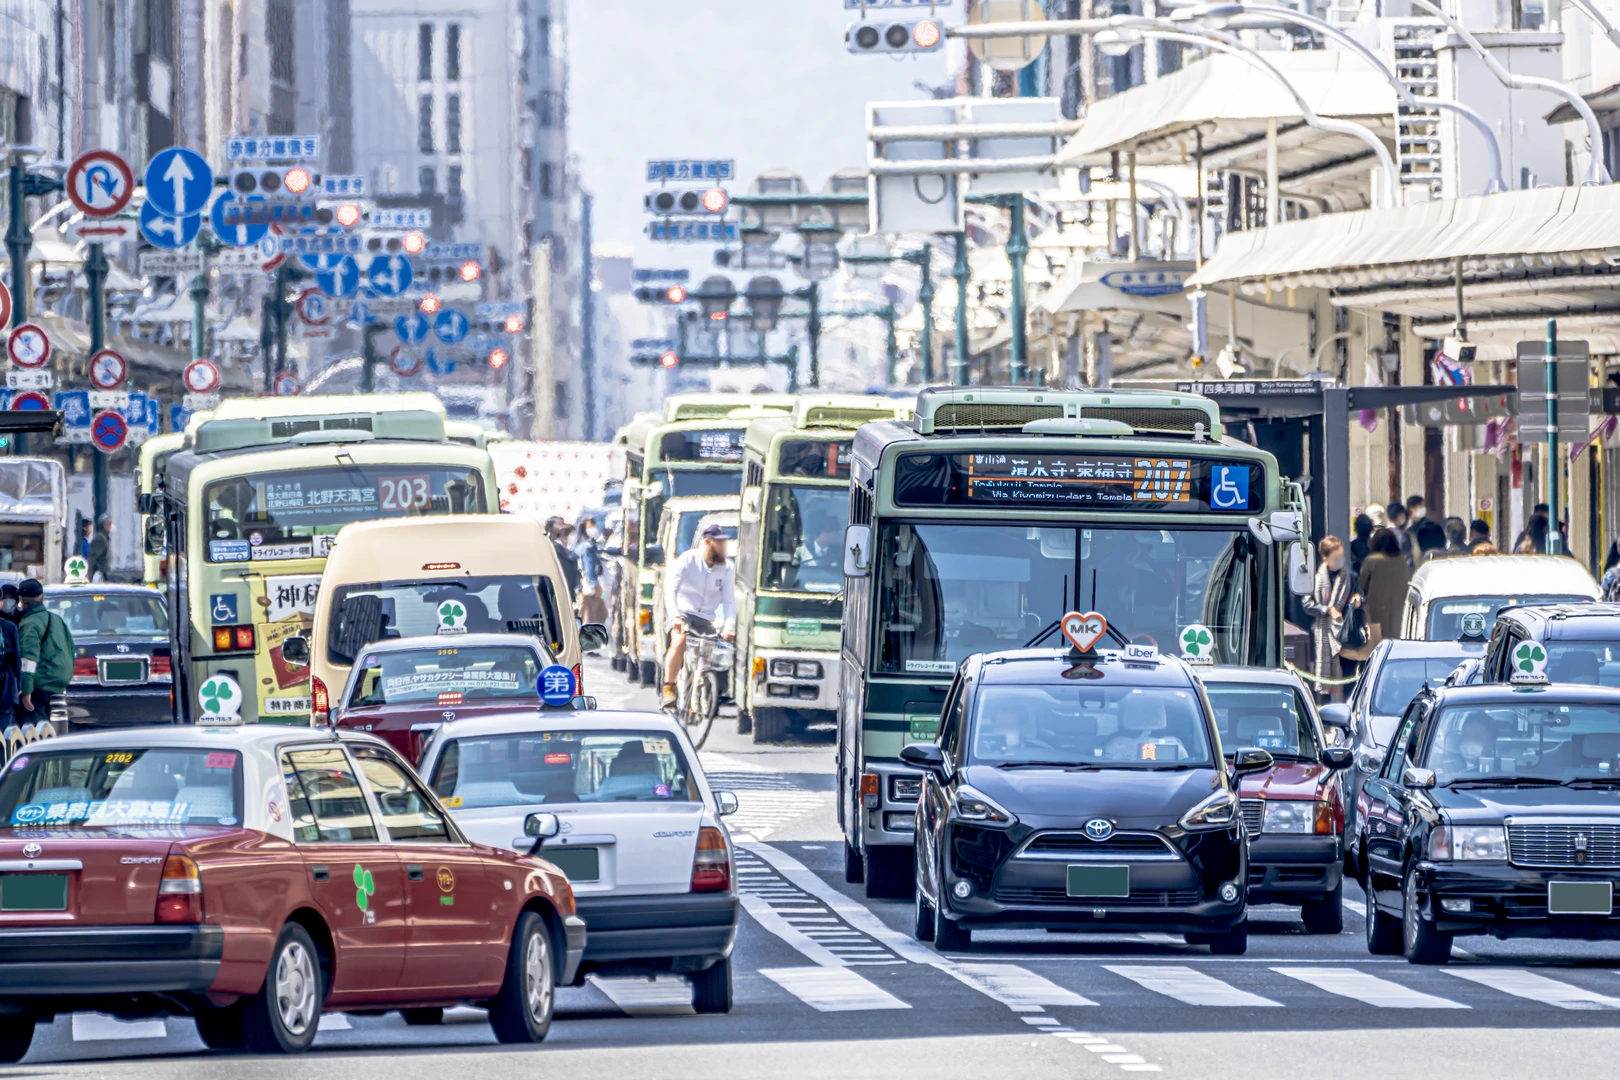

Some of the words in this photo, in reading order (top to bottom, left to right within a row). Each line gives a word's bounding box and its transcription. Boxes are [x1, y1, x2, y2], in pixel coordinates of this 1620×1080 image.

[1204, 383, 1256, 394] 四条河原町
[1137, 459, 1188, 500] 207
[306, 488, 376, 505] 北野天満宮
[381, 478, 428, 510] 203
[1070, 624, 1098, 634] MK
[1128, 646, 1154, 658] Uber
[544, 672, 570, 699] 第一
[105, 753, 133, 763] 2702
